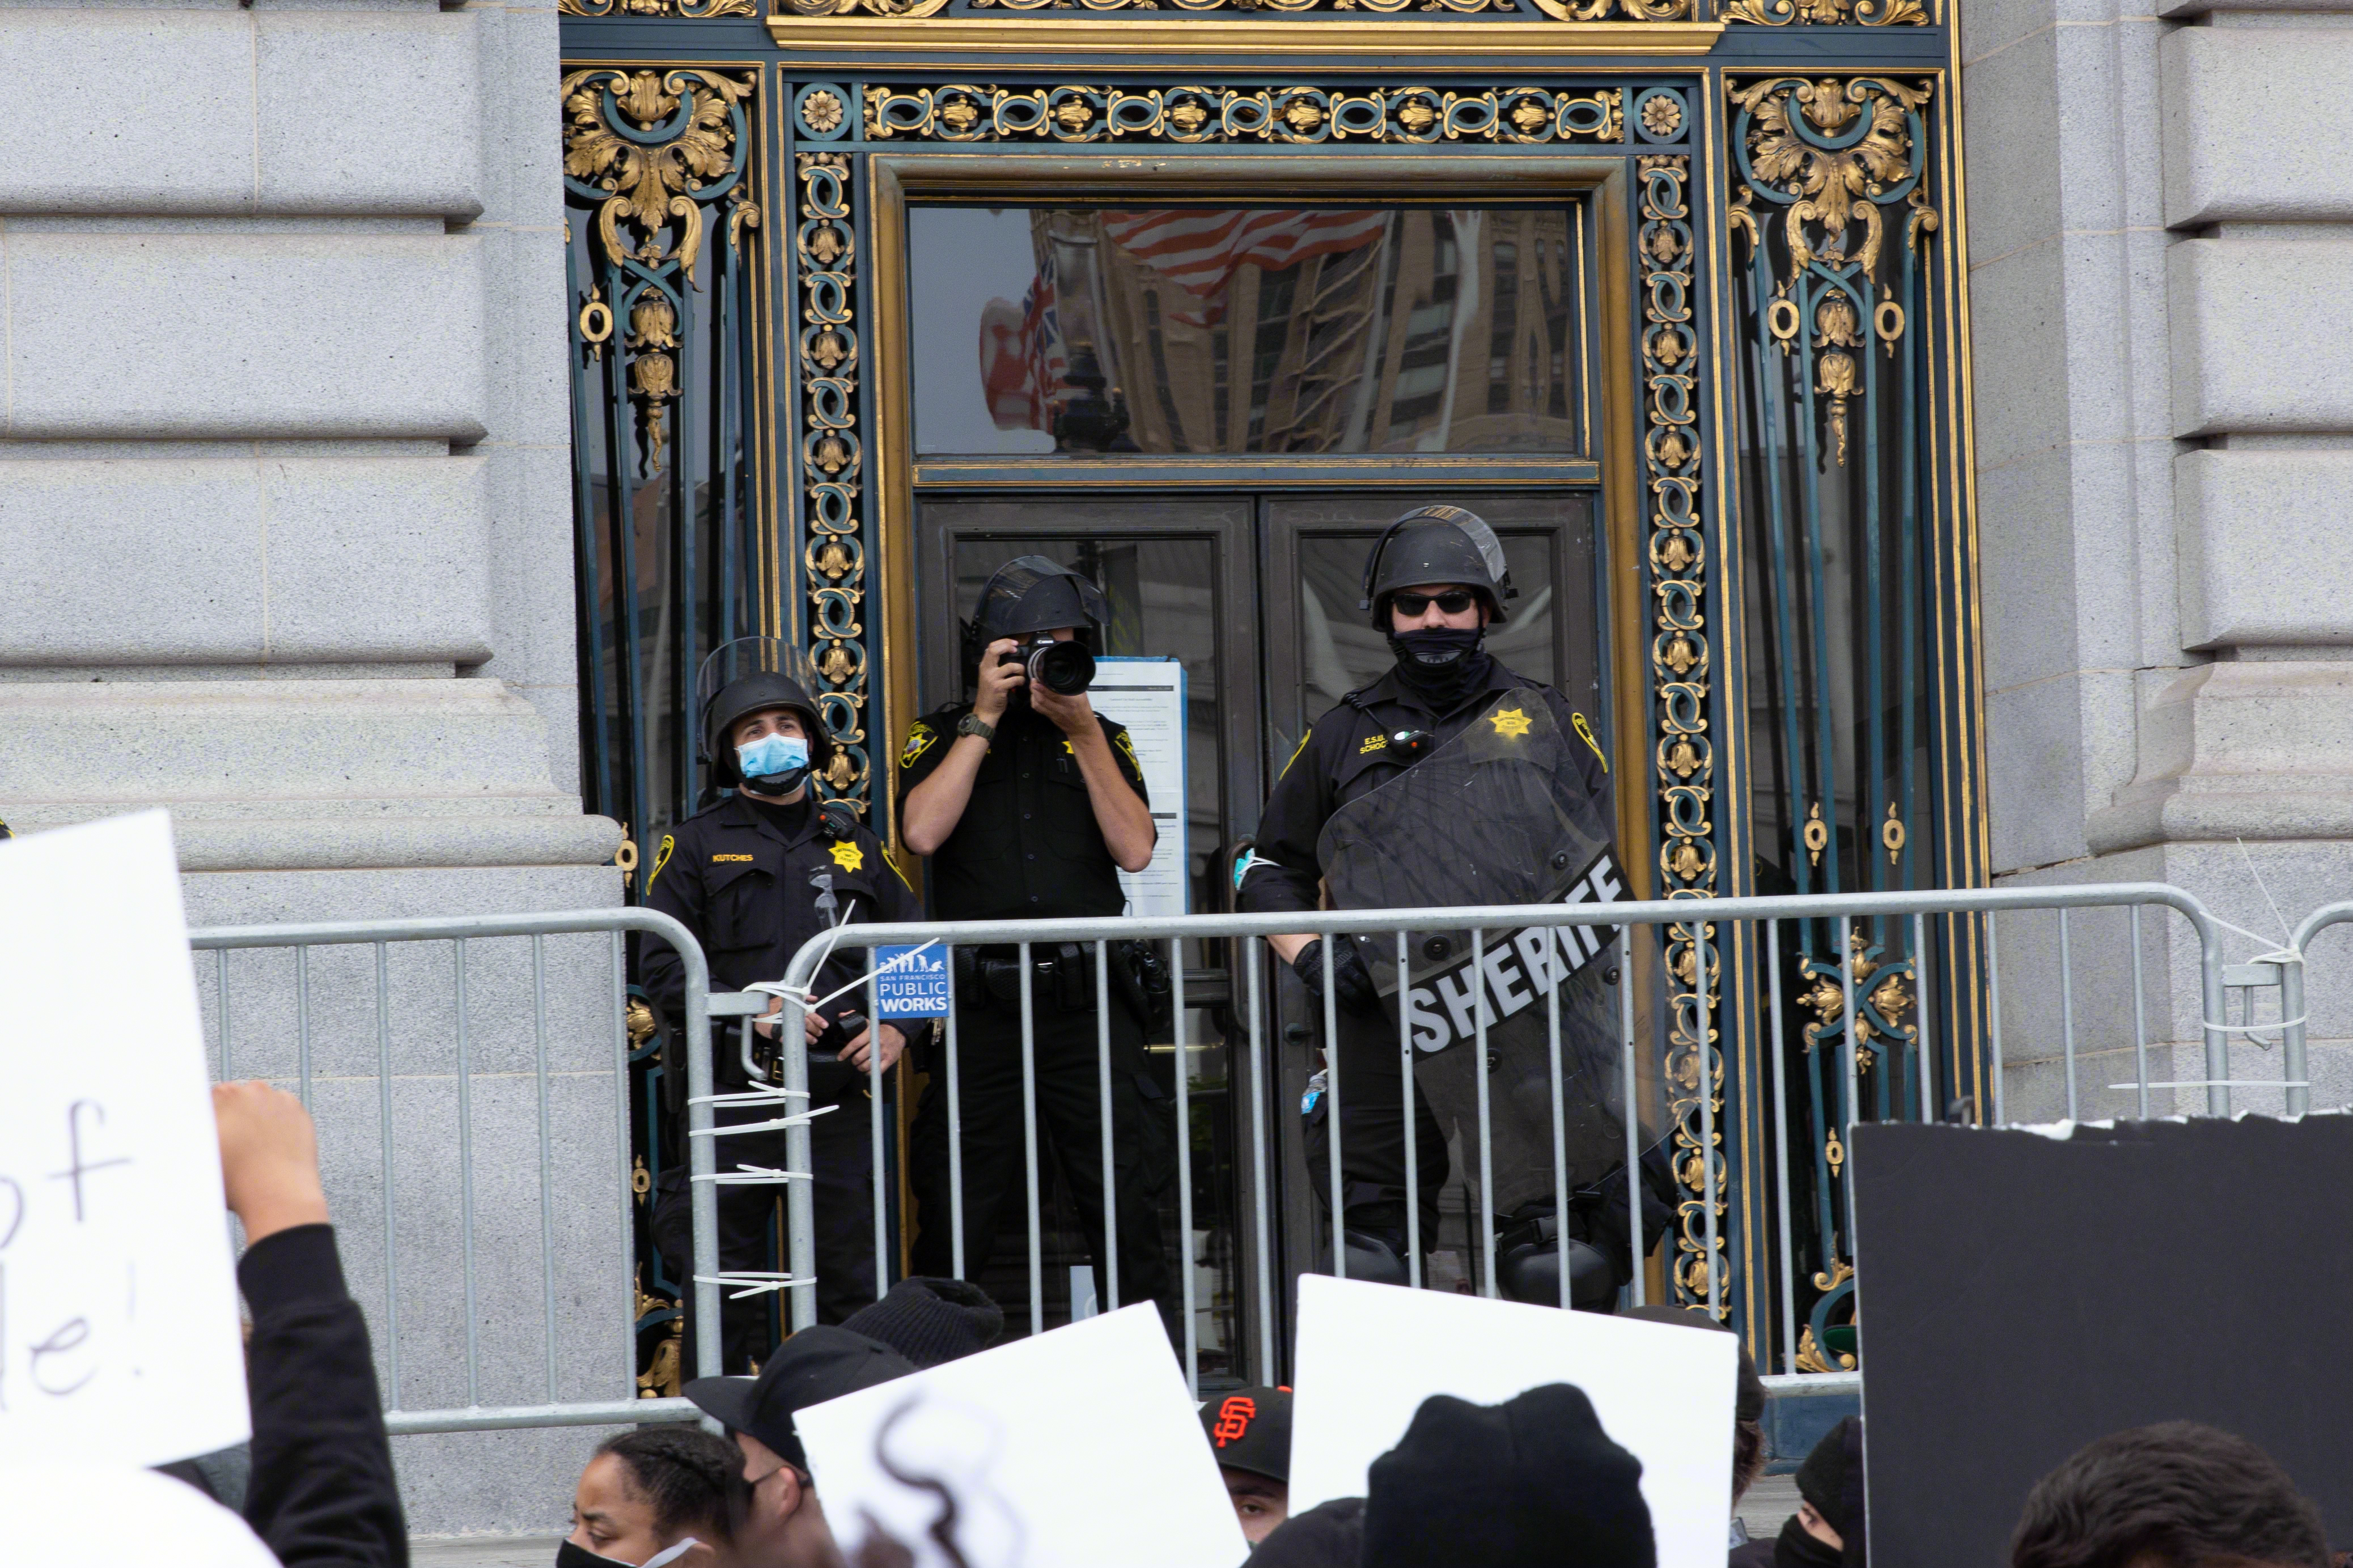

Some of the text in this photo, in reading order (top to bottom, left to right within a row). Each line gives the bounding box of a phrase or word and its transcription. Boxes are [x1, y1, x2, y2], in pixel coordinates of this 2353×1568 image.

[1360, 740, 1388, 754] SCHOC
[713, 854, 754, 862] KUTCHES
[1408, 855, 1622, 1053] SHERIFF
[880, 982, 947, 996] PUBLIC
[880, 997, 948, 1013] WORKS
[1214, 1396, 1256, 1448] SF
